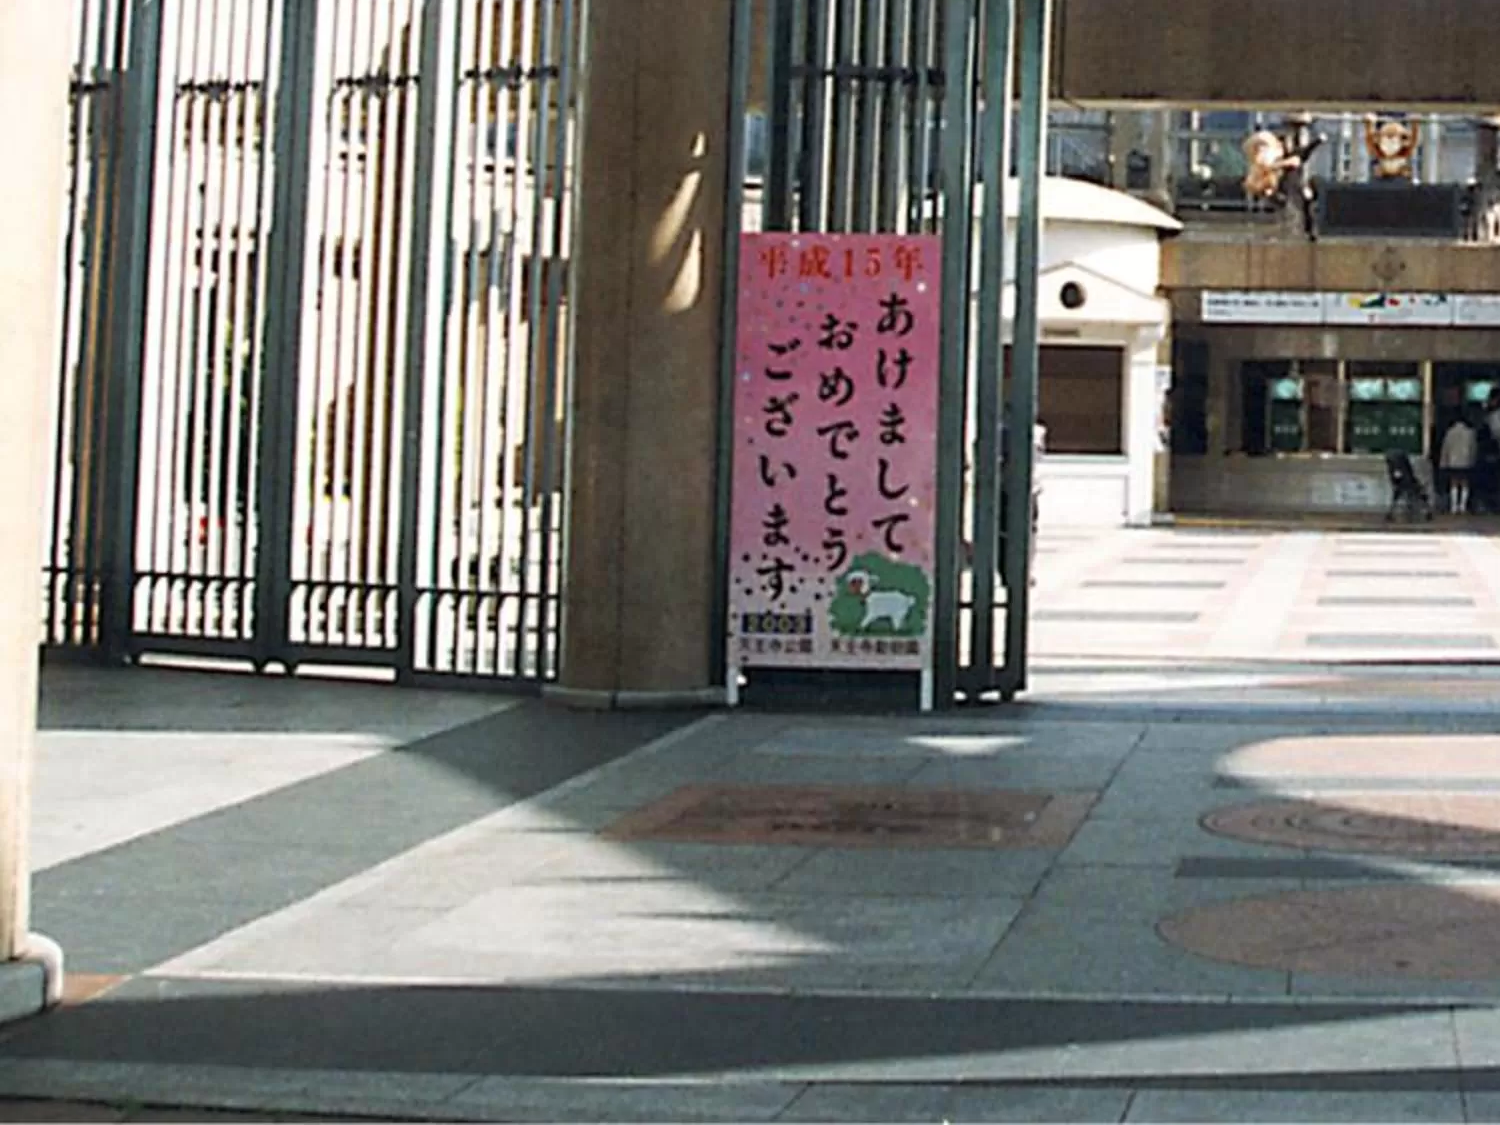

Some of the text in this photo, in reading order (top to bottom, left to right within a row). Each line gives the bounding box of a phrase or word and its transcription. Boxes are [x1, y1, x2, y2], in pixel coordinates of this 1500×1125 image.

[758, 243, 925, 283] 平成15年
[757, 338, 800, 602] ございます
[816, 313, 859, 573] おめでとう
[873, 292, 915, 554] あけまして
